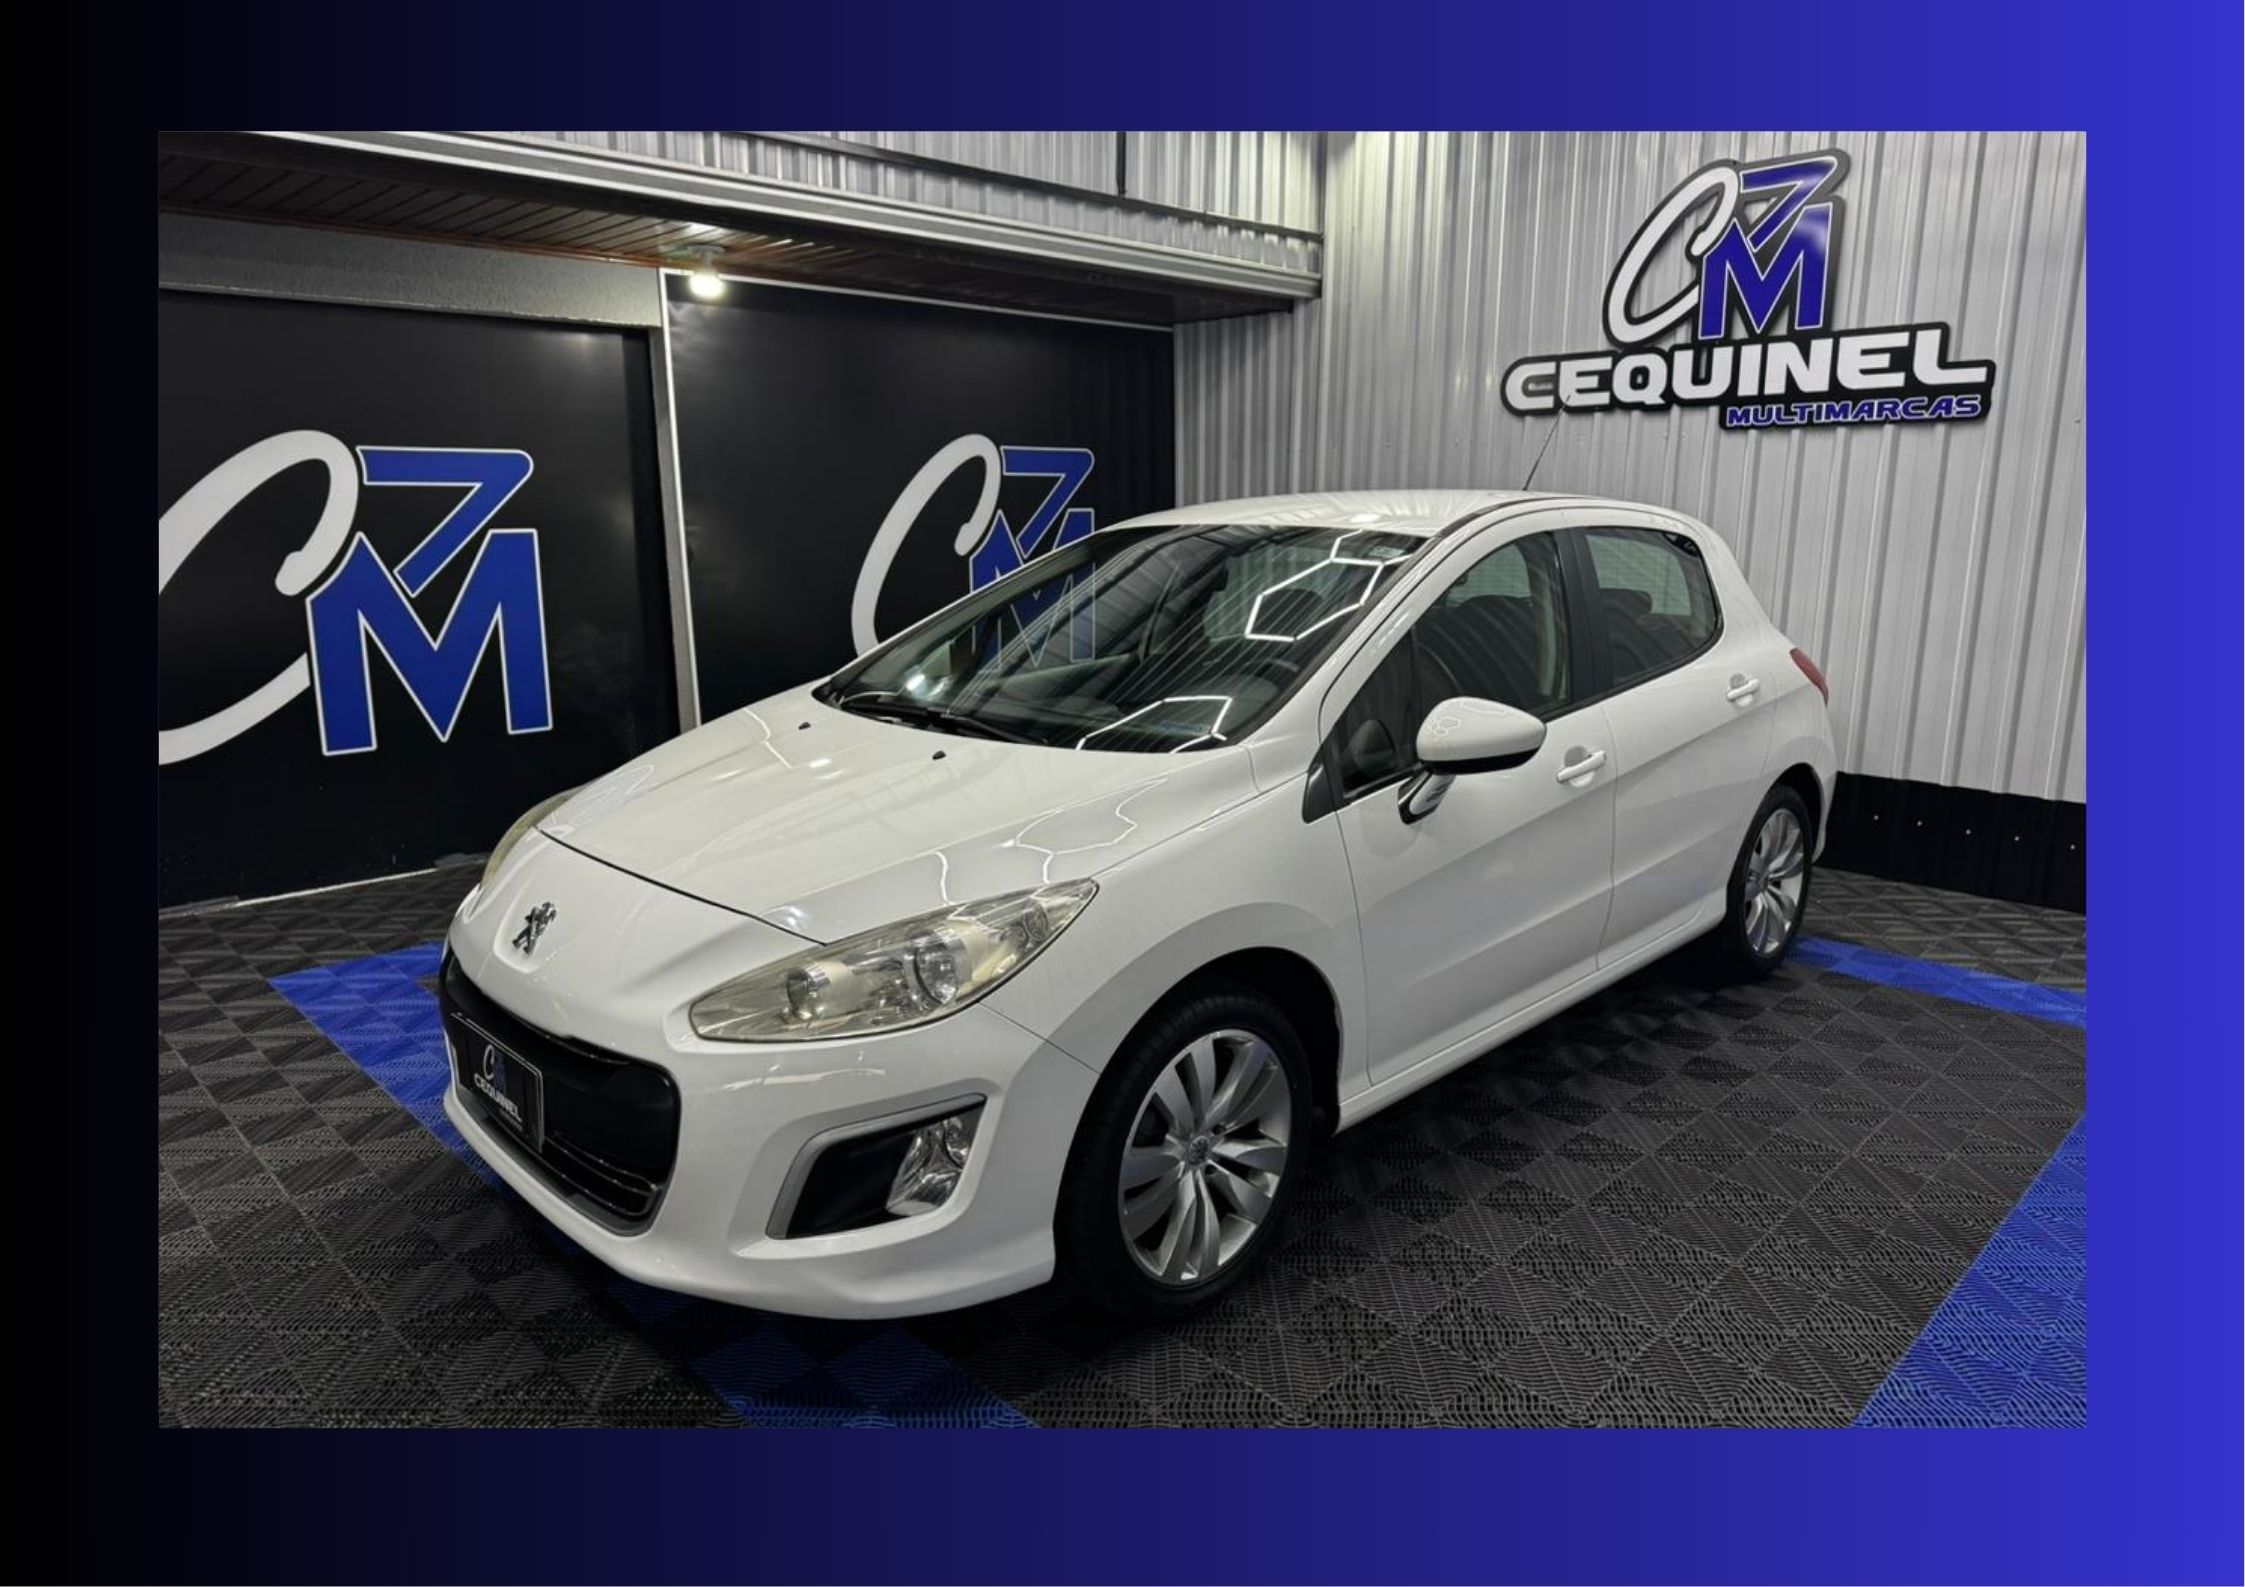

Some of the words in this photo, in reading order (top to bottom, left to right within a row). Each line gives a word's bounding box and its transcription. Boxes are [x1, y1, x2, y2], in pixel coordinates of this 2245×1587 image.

[1505, 328, 1988, 411] CEQUINEL
[1726, 394, 1982, 428] MULTIMARCAS
[474, 1072, 523, 1122] CEQUINEL
